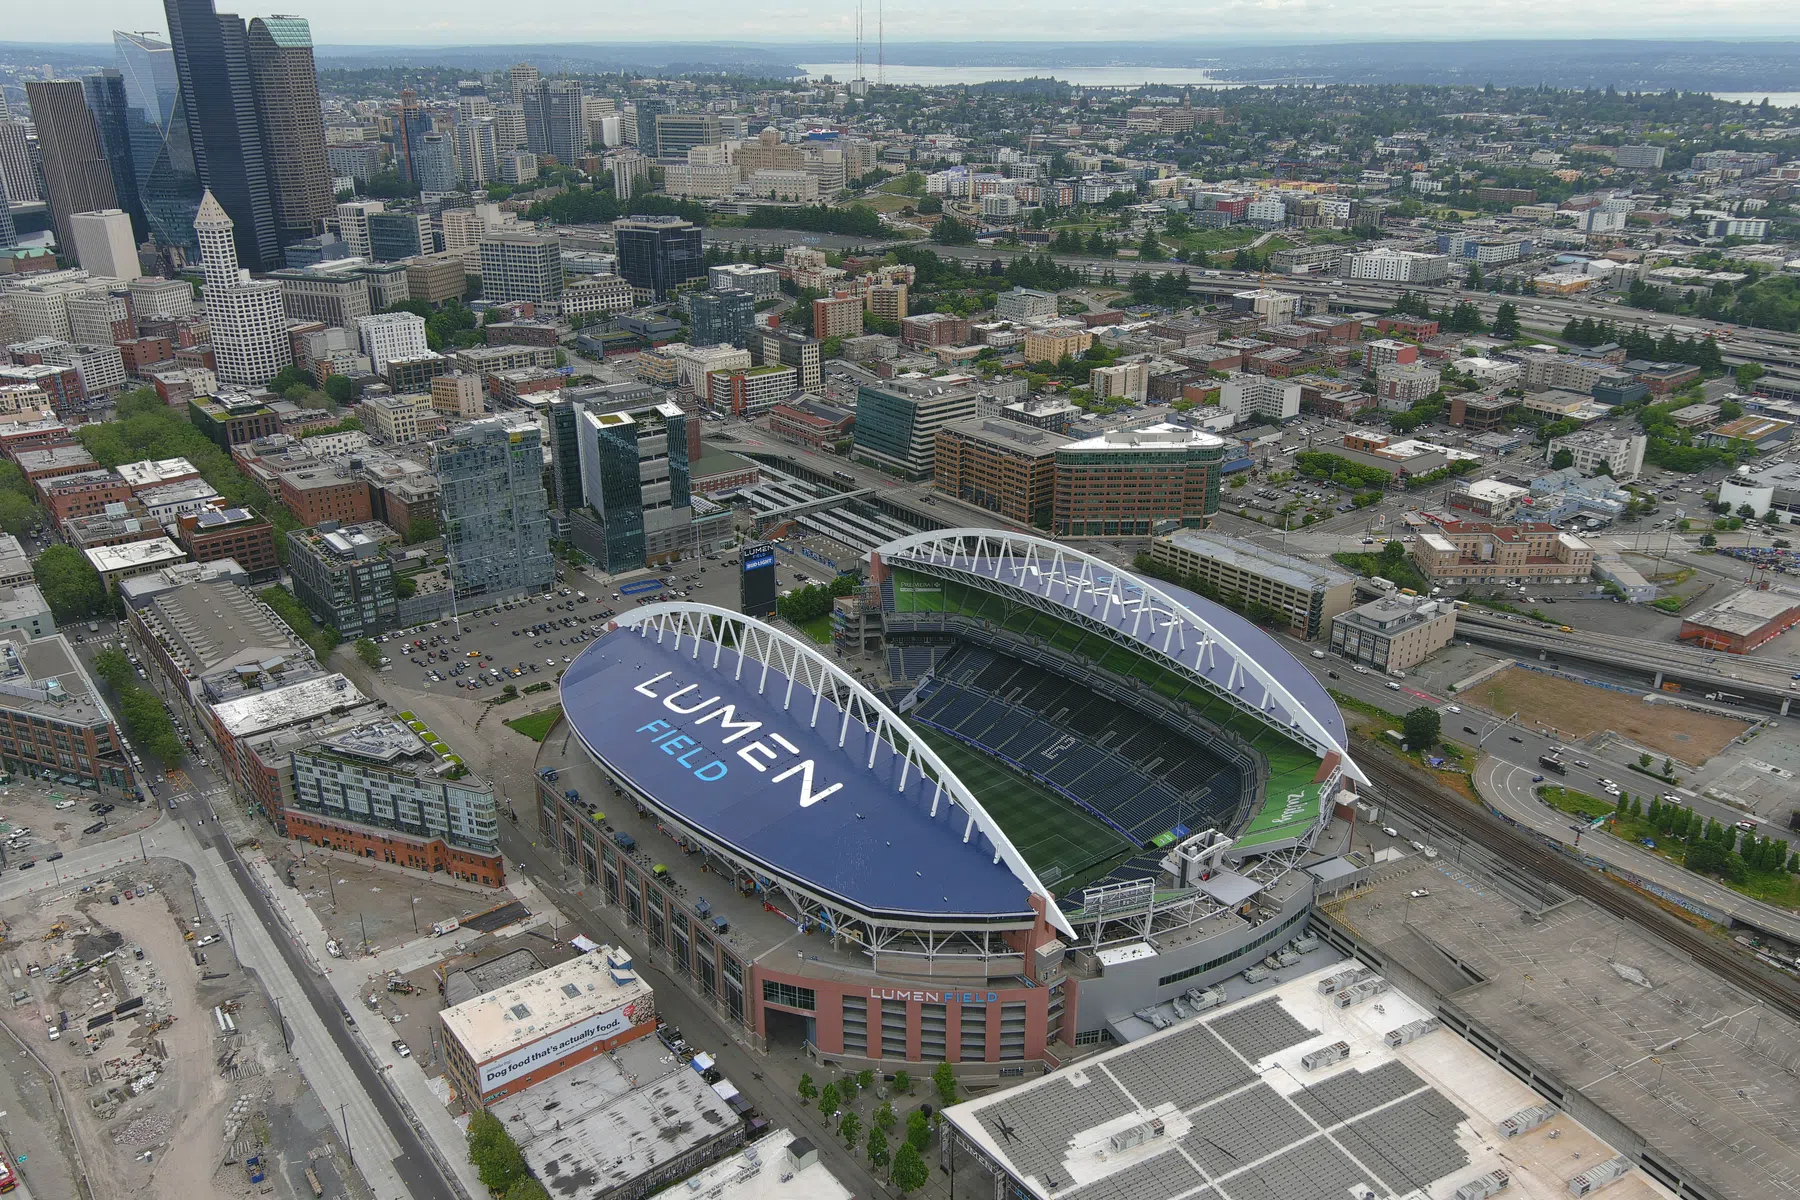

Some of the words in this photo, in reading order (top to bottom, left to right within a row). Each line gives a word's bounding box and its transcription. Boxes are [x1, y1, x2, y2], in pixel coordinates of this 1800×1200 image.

[744, 545, 774, 557] LUMEN
[633, 671, 844, 808] LUMEN
[635, 719, 729, 782] FIELD
[870, 988, 939, 1002] LUMEN
[943, 991, 998, 1003] FIELD
[486, 1068, 507, 1082] Dog
[508, 1055, 531, 1072] food
[559, 1027, 596, 1049] actually
[596, 1018, 621, 1032] food.
